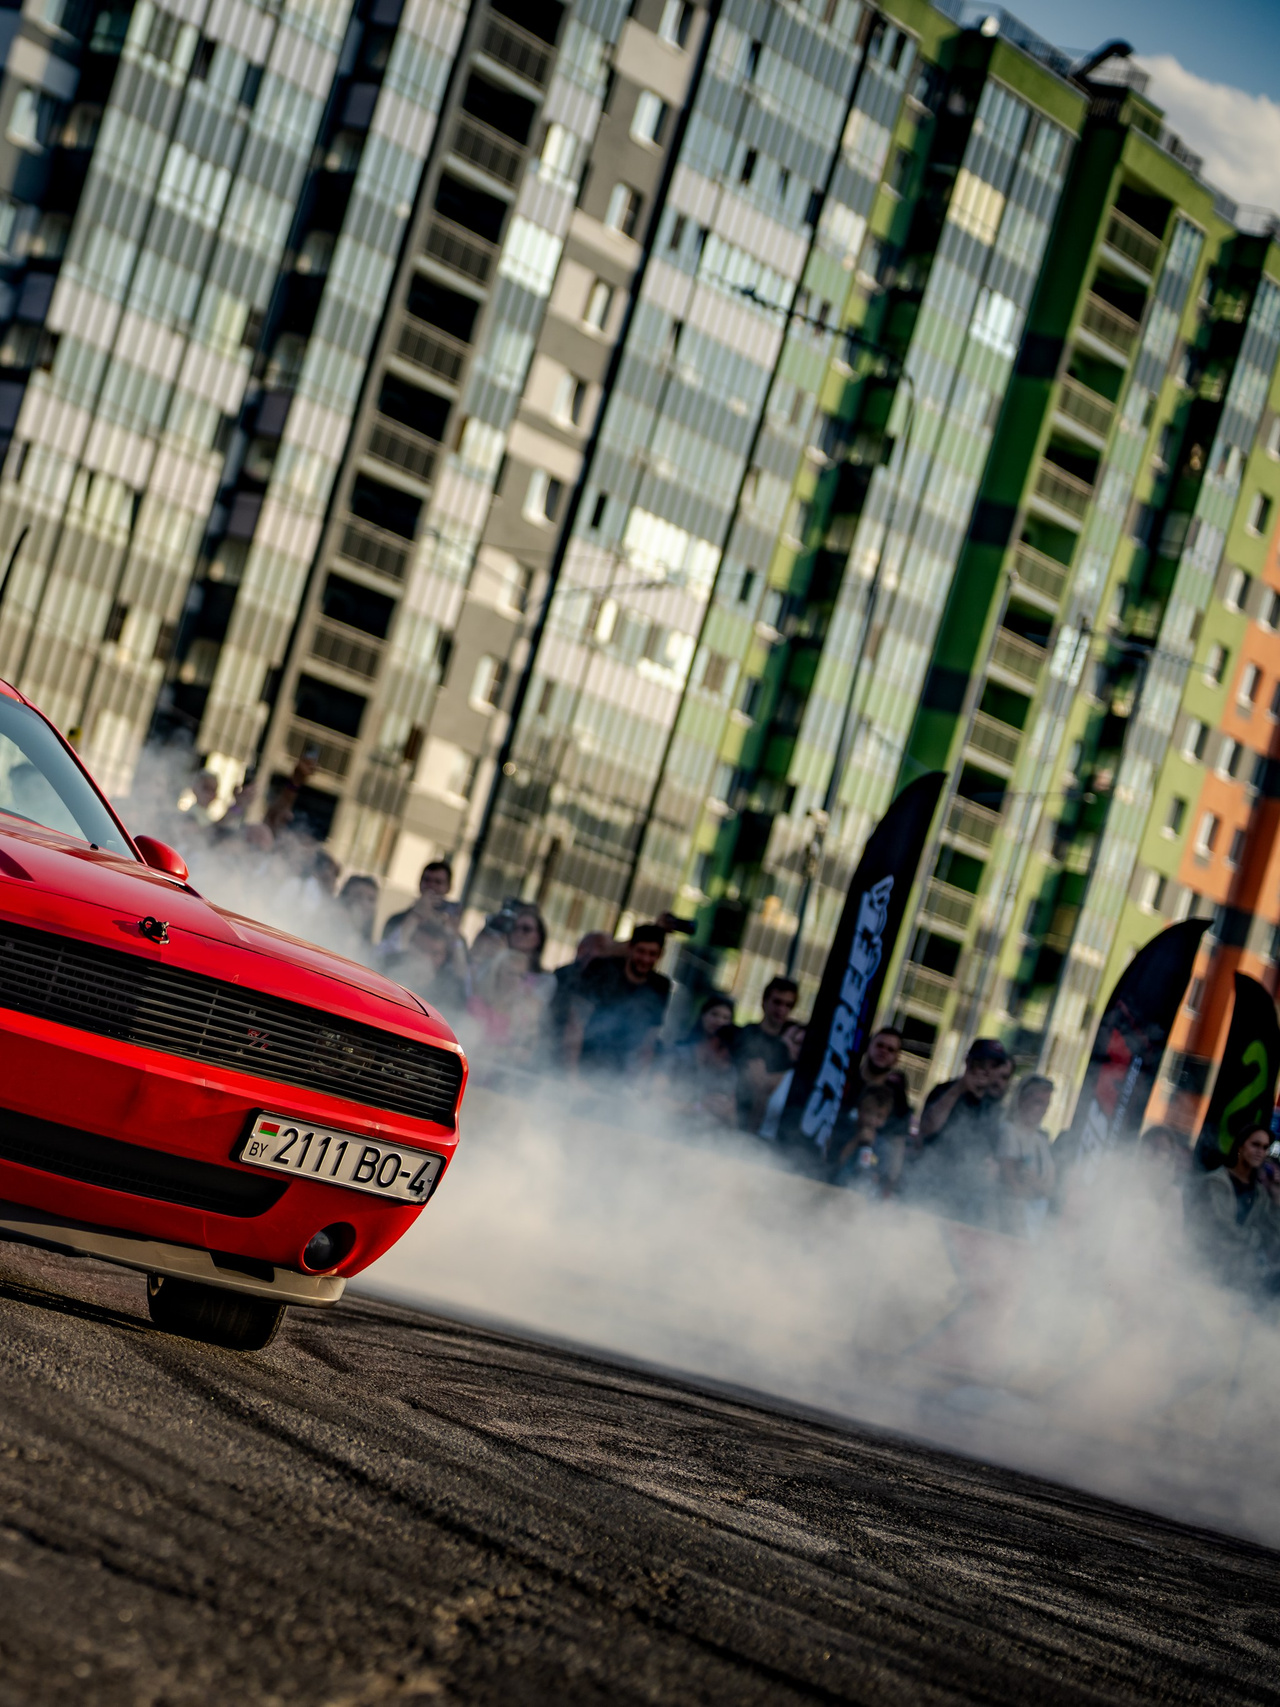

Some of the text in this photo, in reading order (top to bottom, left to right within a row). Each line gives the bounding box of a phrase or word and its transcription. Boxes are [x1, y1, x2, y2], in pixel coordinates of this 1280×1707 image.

[800, 890, 884, 1145] STREET
[249, 1127, 431, 1195] BY 2111 BO-4
